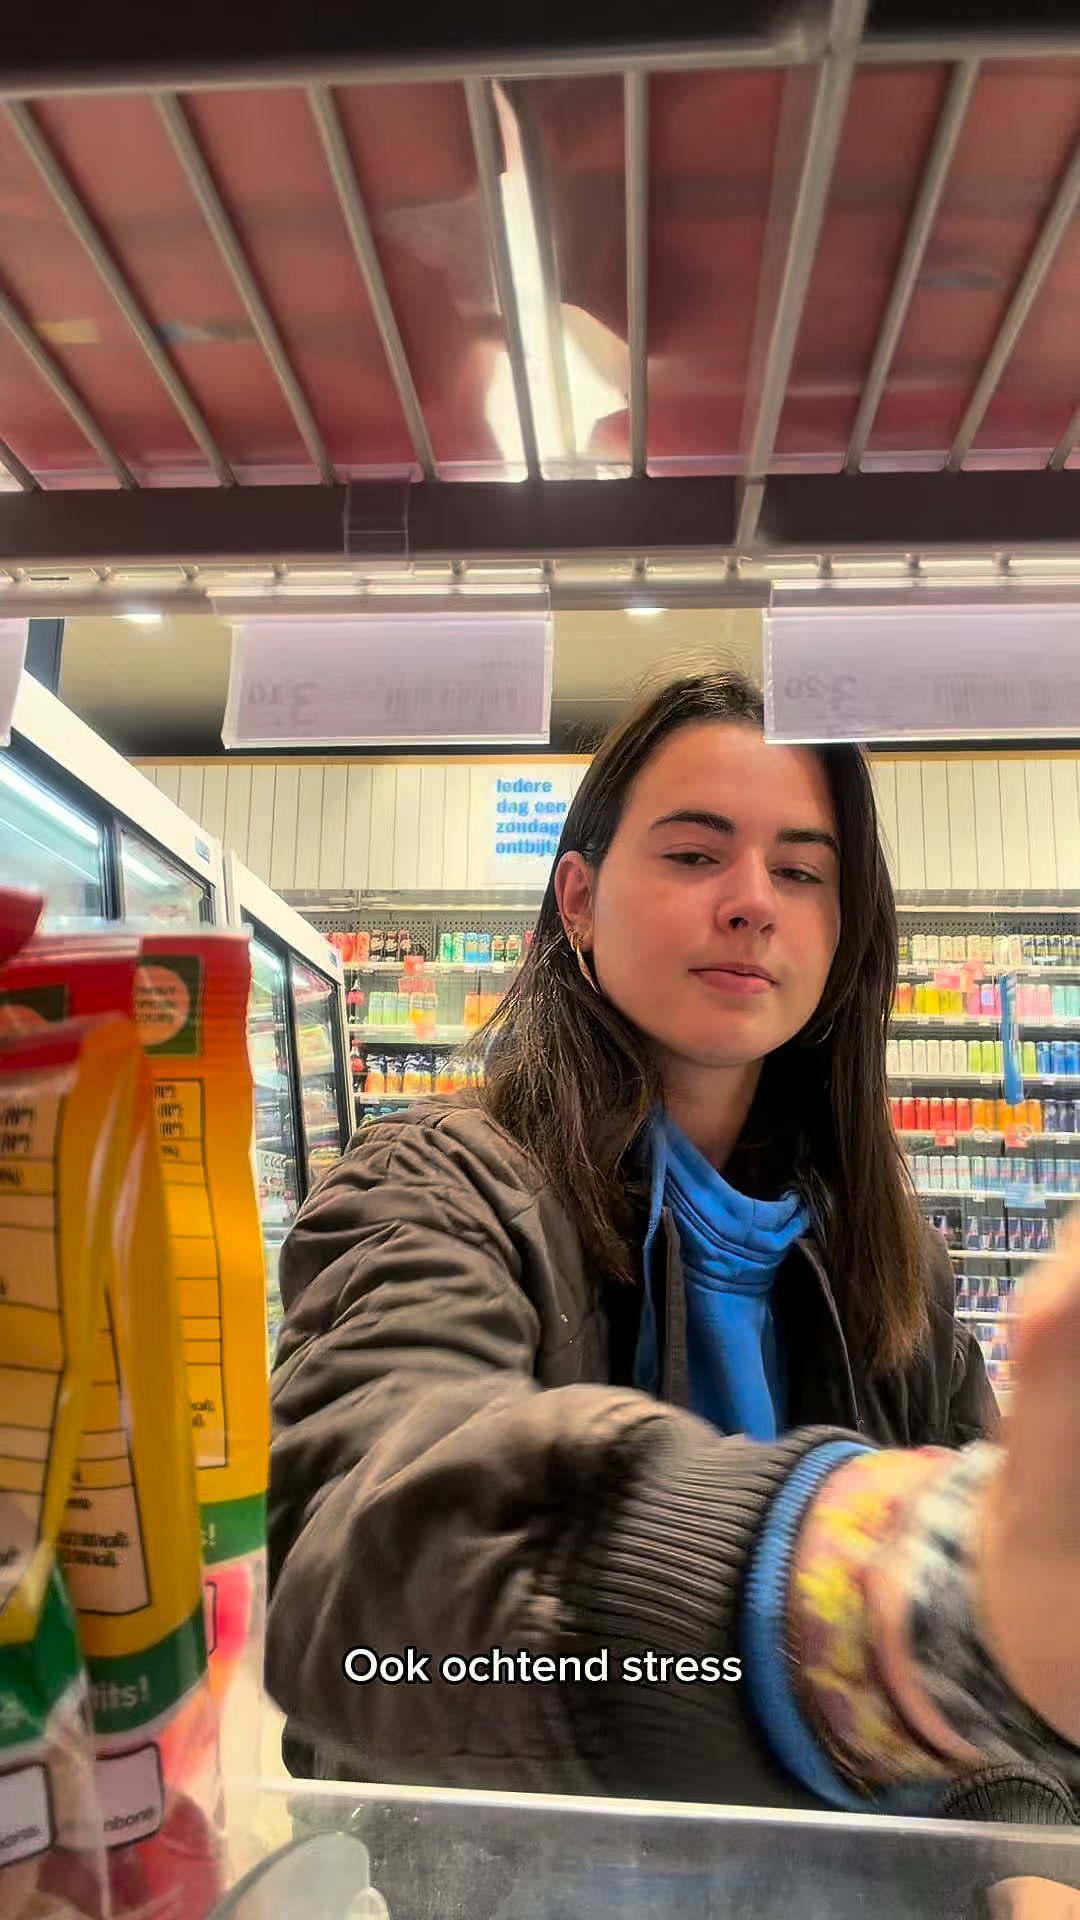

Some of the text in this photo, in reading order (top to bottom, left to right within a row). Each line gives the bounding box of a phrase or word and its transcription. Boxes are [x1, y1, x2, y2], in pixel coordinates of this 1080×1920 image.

[496, 778, 552, 793] Iedere
[496, 799, 567, 817] dag een
[496, 819, 562, 837] zondag
